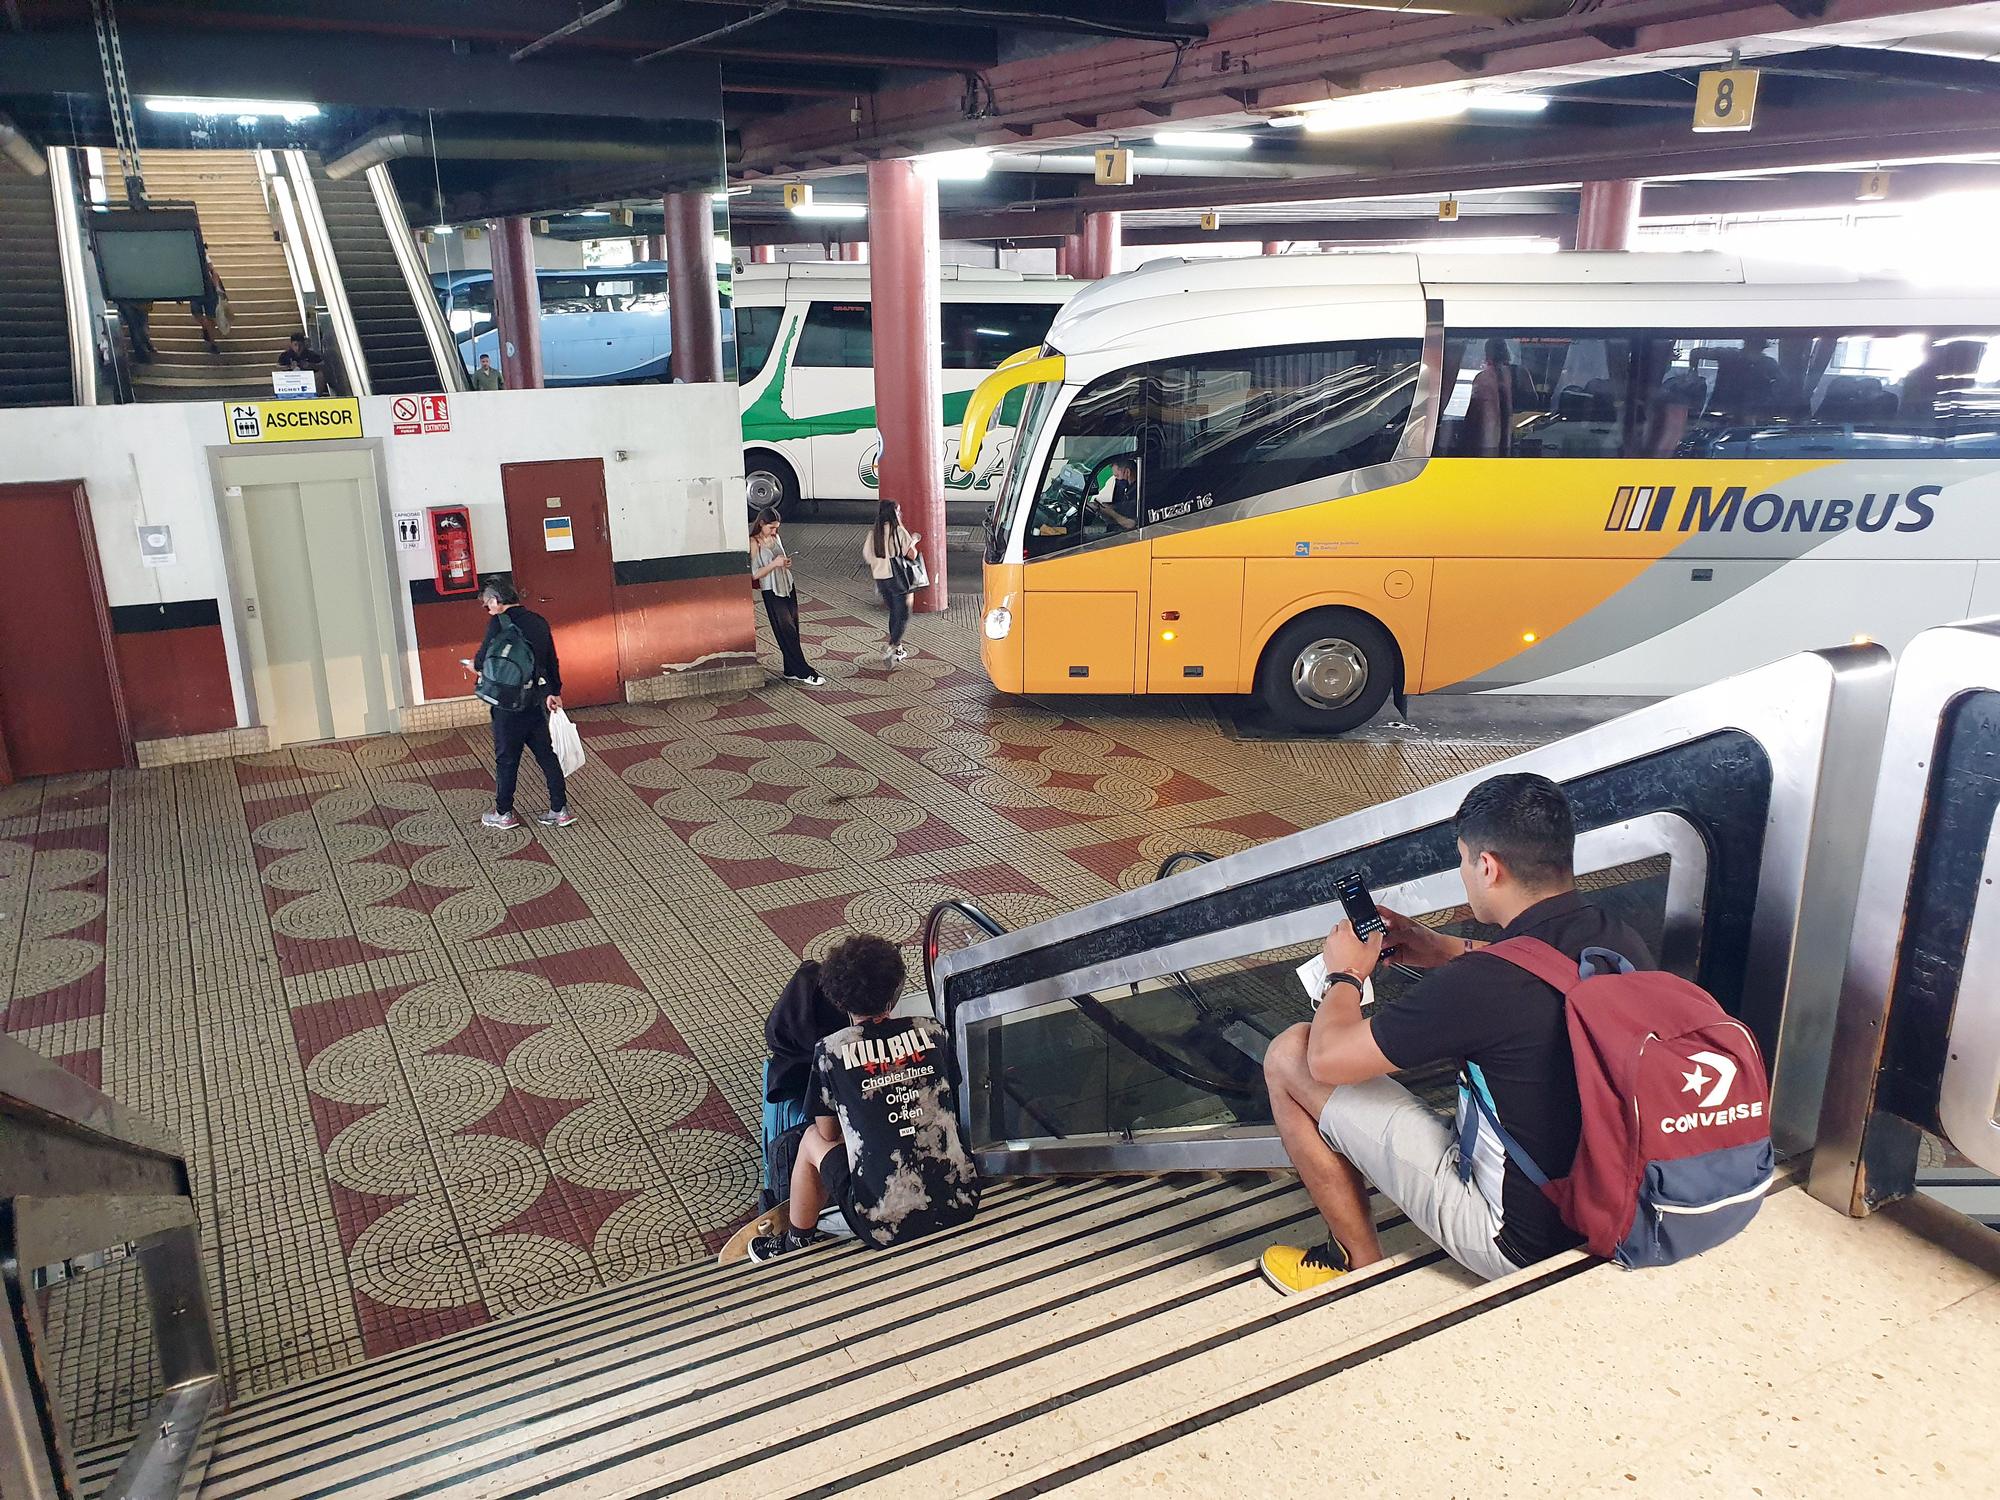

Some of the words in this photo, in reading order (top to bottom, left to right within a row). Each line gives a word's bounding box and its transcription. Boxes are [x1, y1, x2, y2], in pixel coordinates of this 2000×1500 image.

[1714, 78, 1734, 117] 8
[1105, 155, 1114, 177] 7
[1871, 175, 1879, 194] 6
[791, 187, 798, 204] 6
[1445, 202, 1451, 216] 5
[1205, 215, 1211, 226] 4
[266, 410, 353, 428] ASCENSOR
[425, 423, 449, 432] EXTINTOR
[1196, 492, 1214, 510] i6
[1677, 485, 1943, 533] MONBUS
[841, 1038, 891, 1071] KILL
[887, 1027, 936, 1062] BILL
[861, 1071, 905, 1089] Chapter
[906, 1065, 934, 1078] Three
[886, 1089, 920, 1104] Origin
[888, 1107, 924, 1123] O-Ren
[1660, 1101, 1763, 1134] CONVERSE
